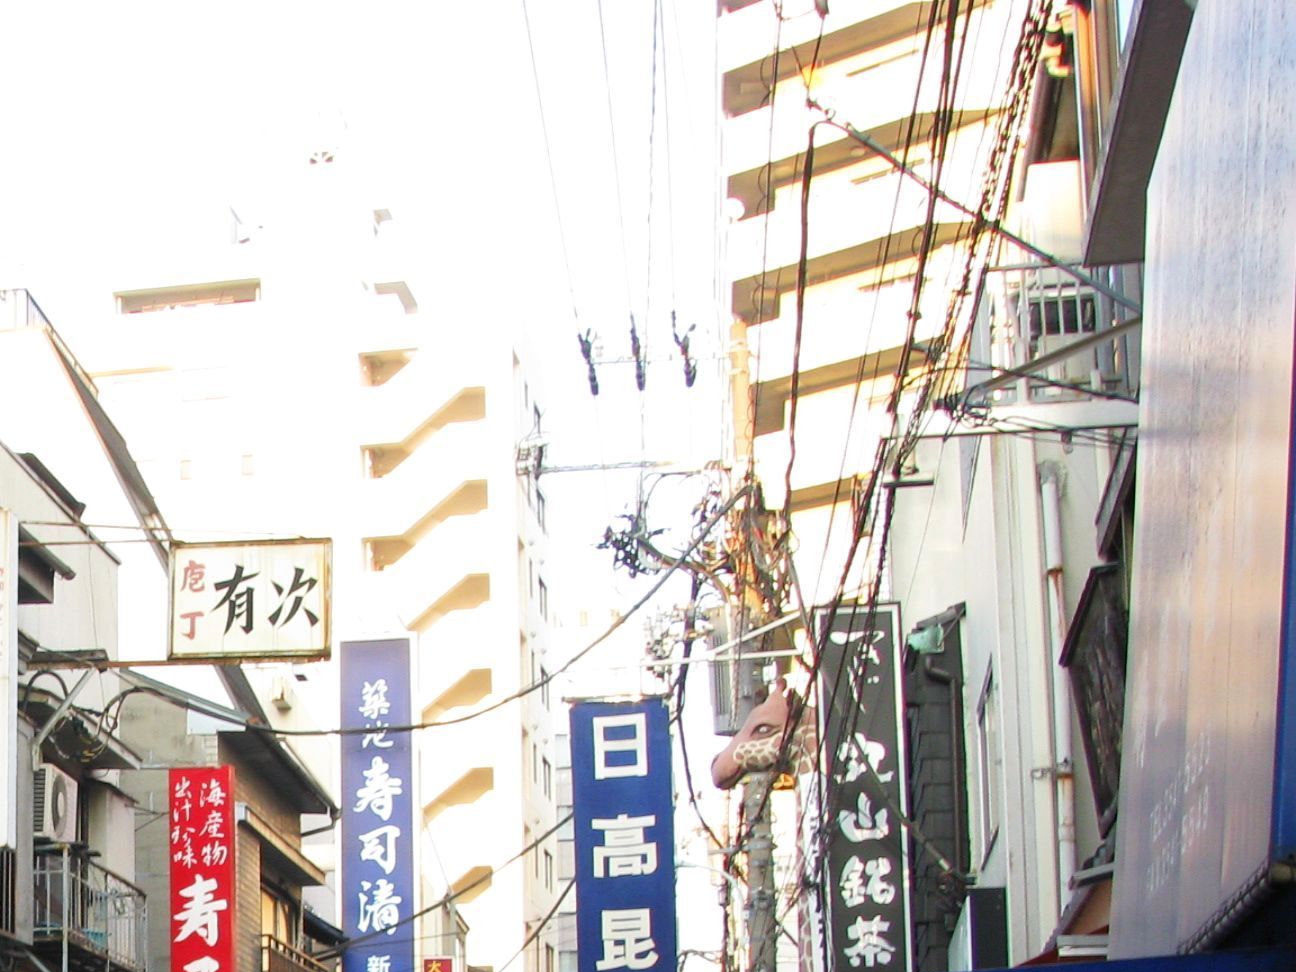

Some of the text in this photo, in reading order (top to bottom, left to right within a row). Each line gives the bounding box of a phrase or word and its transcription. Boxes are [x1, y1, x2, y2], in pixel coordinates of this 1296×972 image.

[179, 560, 205, 640] 庖丁
[210, 564, 319, 636] 有次
[358, 679, 394, 750] 築地
[199, 781, 228, 867] 海産物
[353, 755, 403, 935] 寿司清
